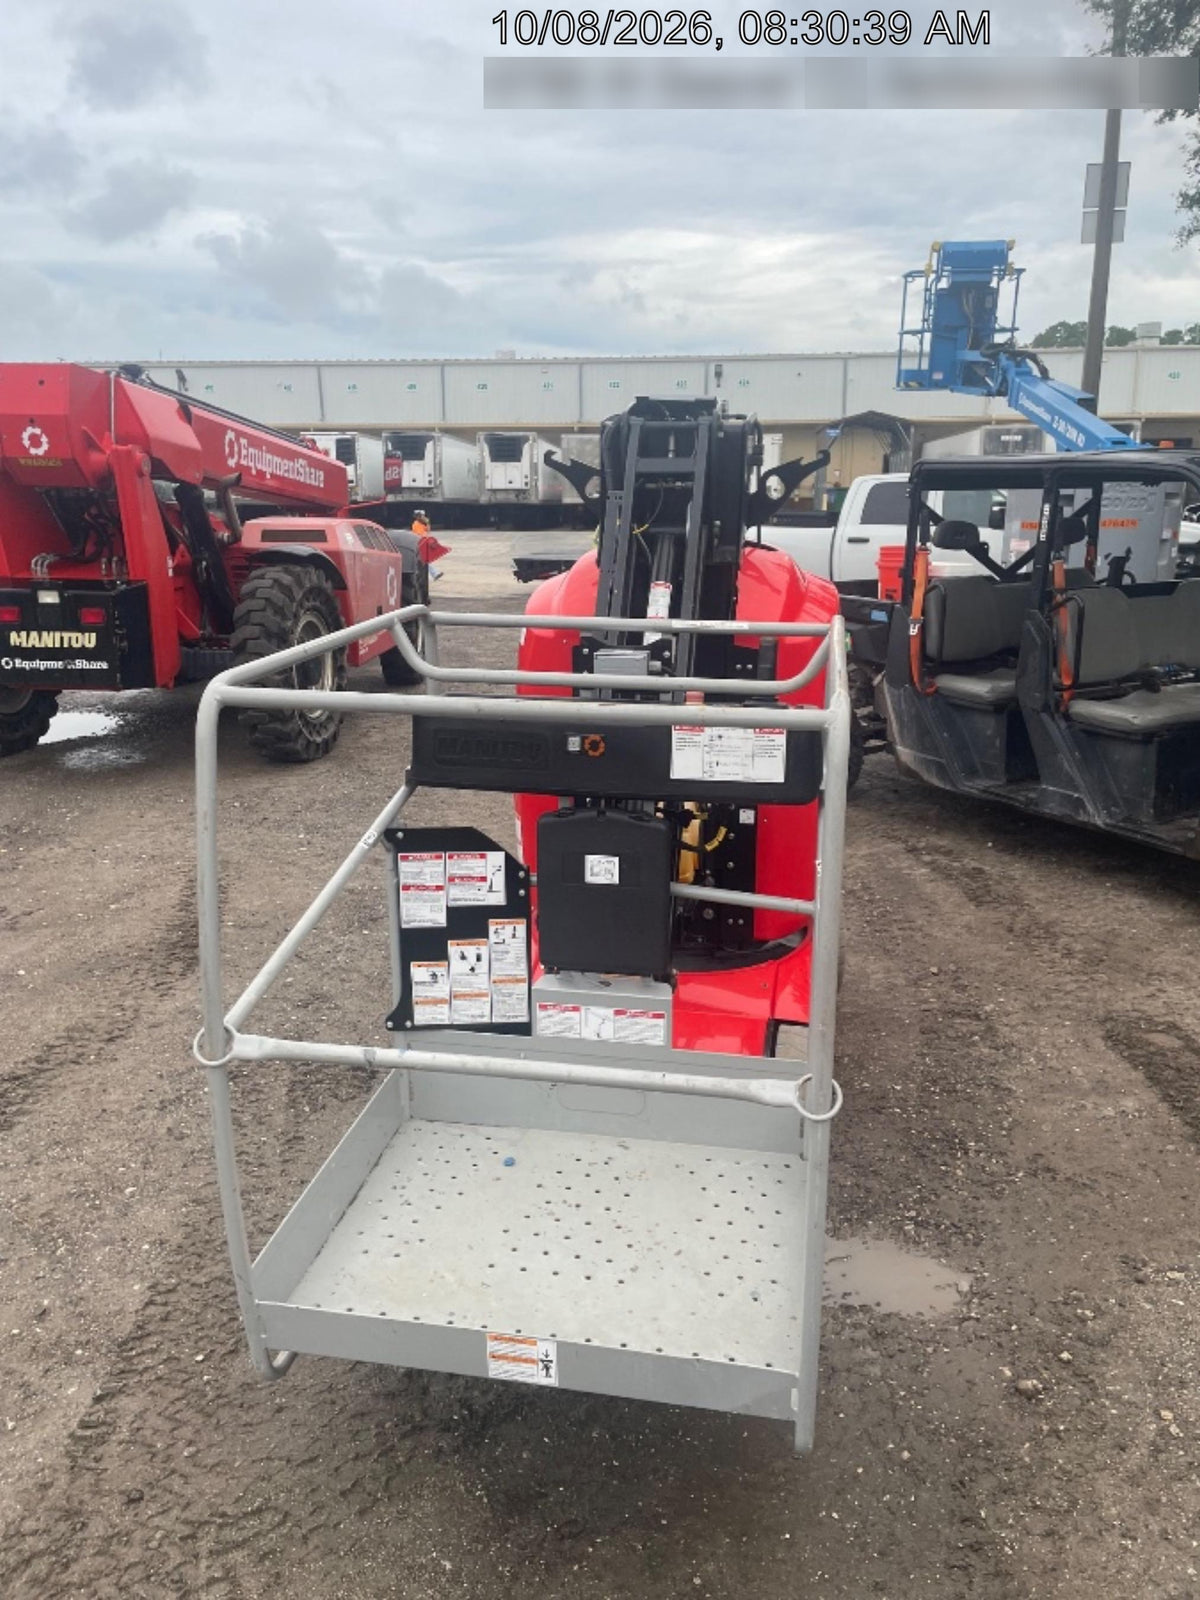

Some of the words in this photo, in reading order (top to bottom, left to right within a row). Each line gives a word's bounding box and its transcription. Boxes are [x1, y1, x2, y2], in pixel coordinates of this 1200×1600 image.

[239, 437, 325, 488] EquipmentShare
[9, 630, 97, 648] MANITOU
[14, 658, 109, 671] EquipmeShare
